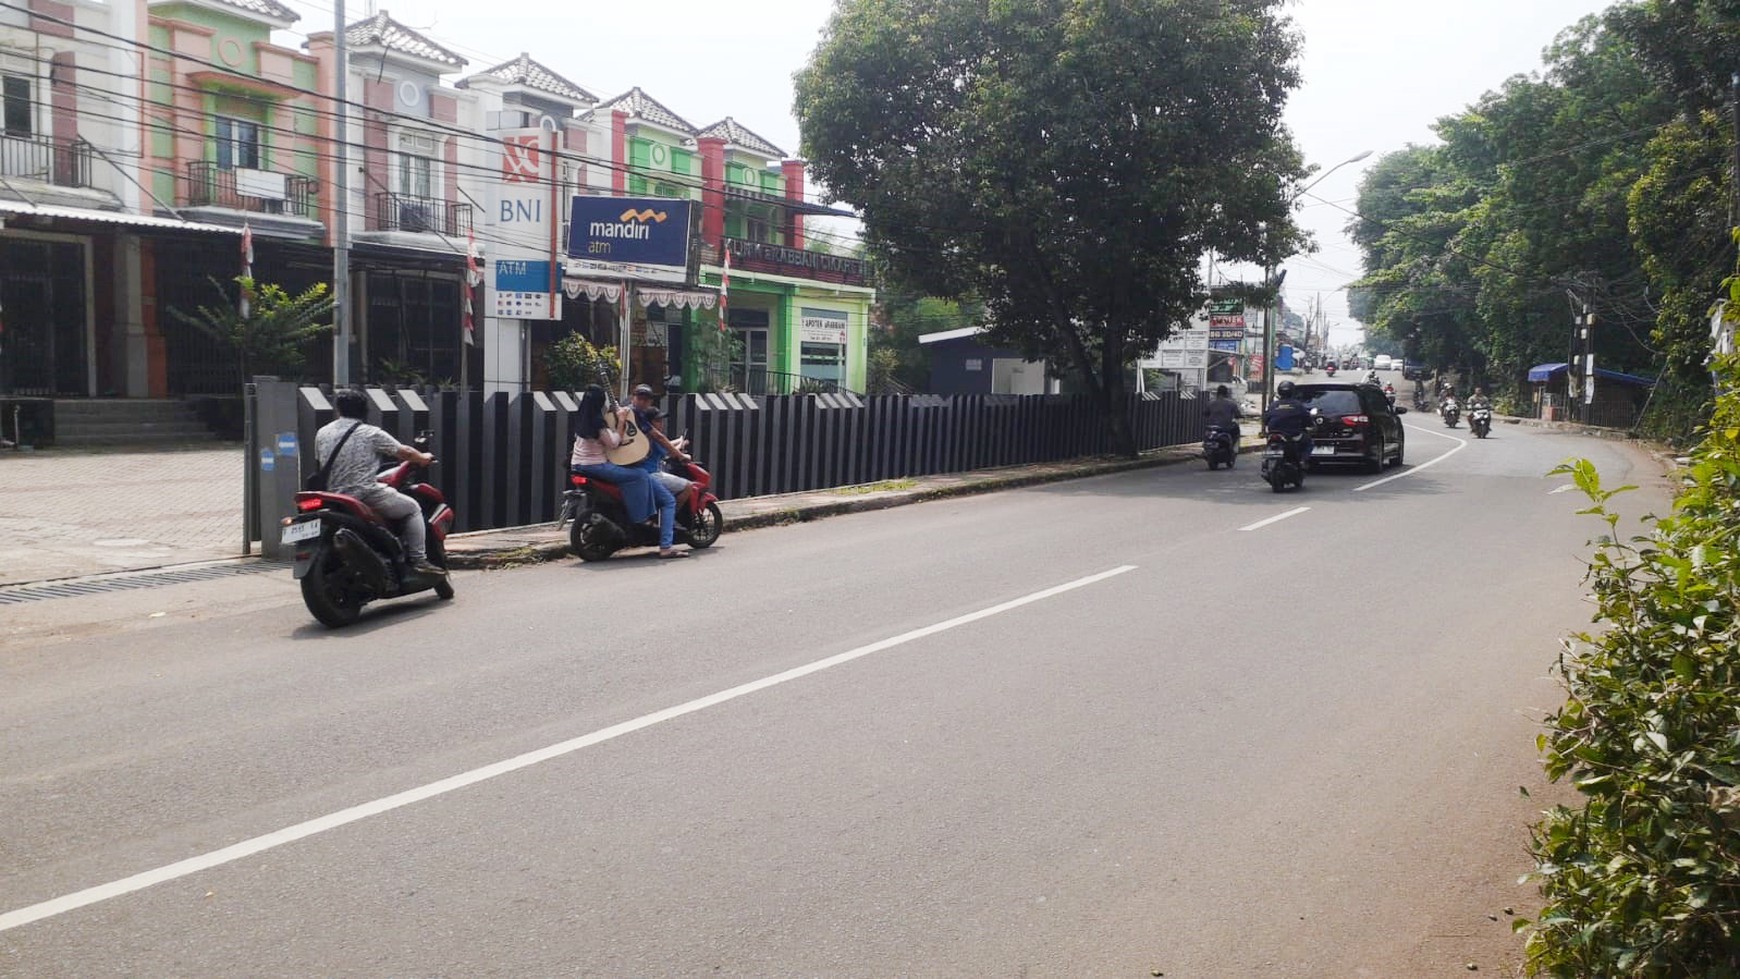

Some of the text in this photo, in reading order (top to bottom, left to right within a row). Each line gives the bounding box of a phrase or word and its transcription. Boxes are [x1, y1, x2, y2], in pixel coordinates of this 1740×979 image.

[500, 200, 541, 222] BNI
[590, 219, 649, 240] mandiri
[588, 241, 611, 253] atm
[499, 261, 526, 275] ATM
